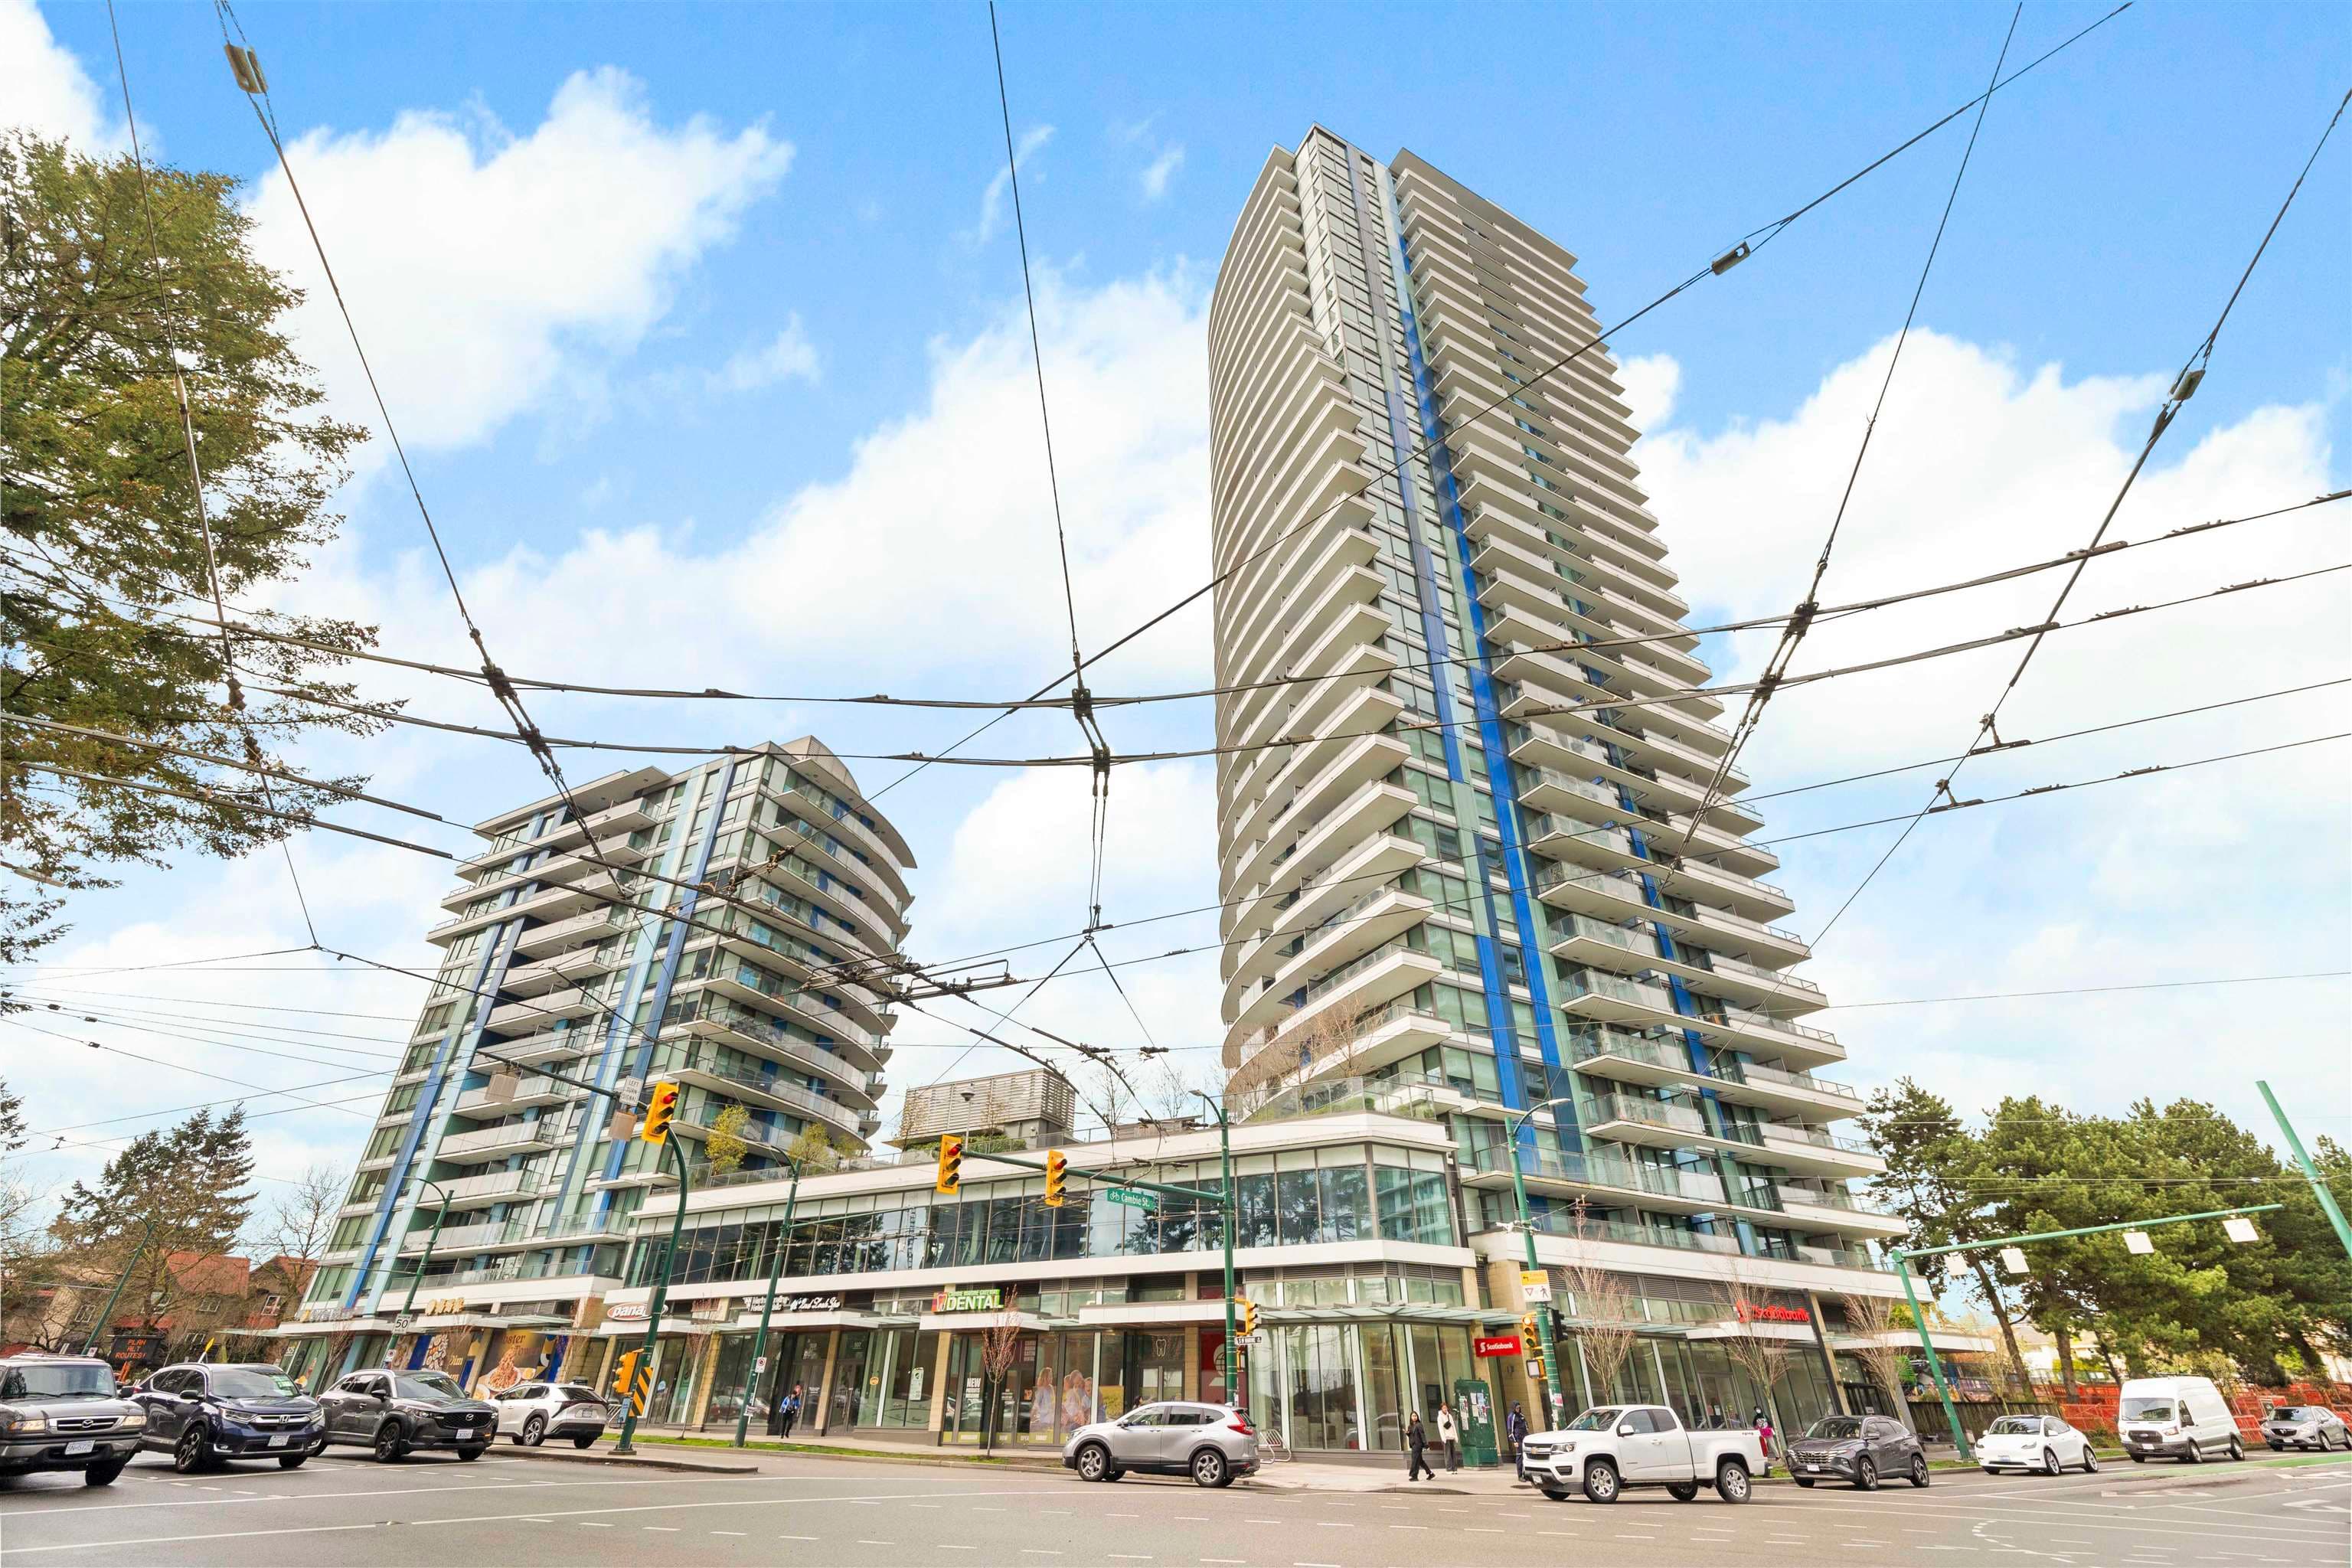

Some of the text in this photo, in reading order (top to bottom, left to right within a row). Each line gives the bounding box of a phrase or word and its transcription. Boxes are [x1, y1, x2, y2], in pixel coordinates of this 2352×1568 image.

[1121, 1193, 1150, 1207] Cambie St.
[946, 1295, 1004, 1311] DENTAL
[395, 1319, 409, 1328] 50
[1487, 1341, 1514, 1350] Scotiabank
[966, 1378, 981, 1387] NEW
